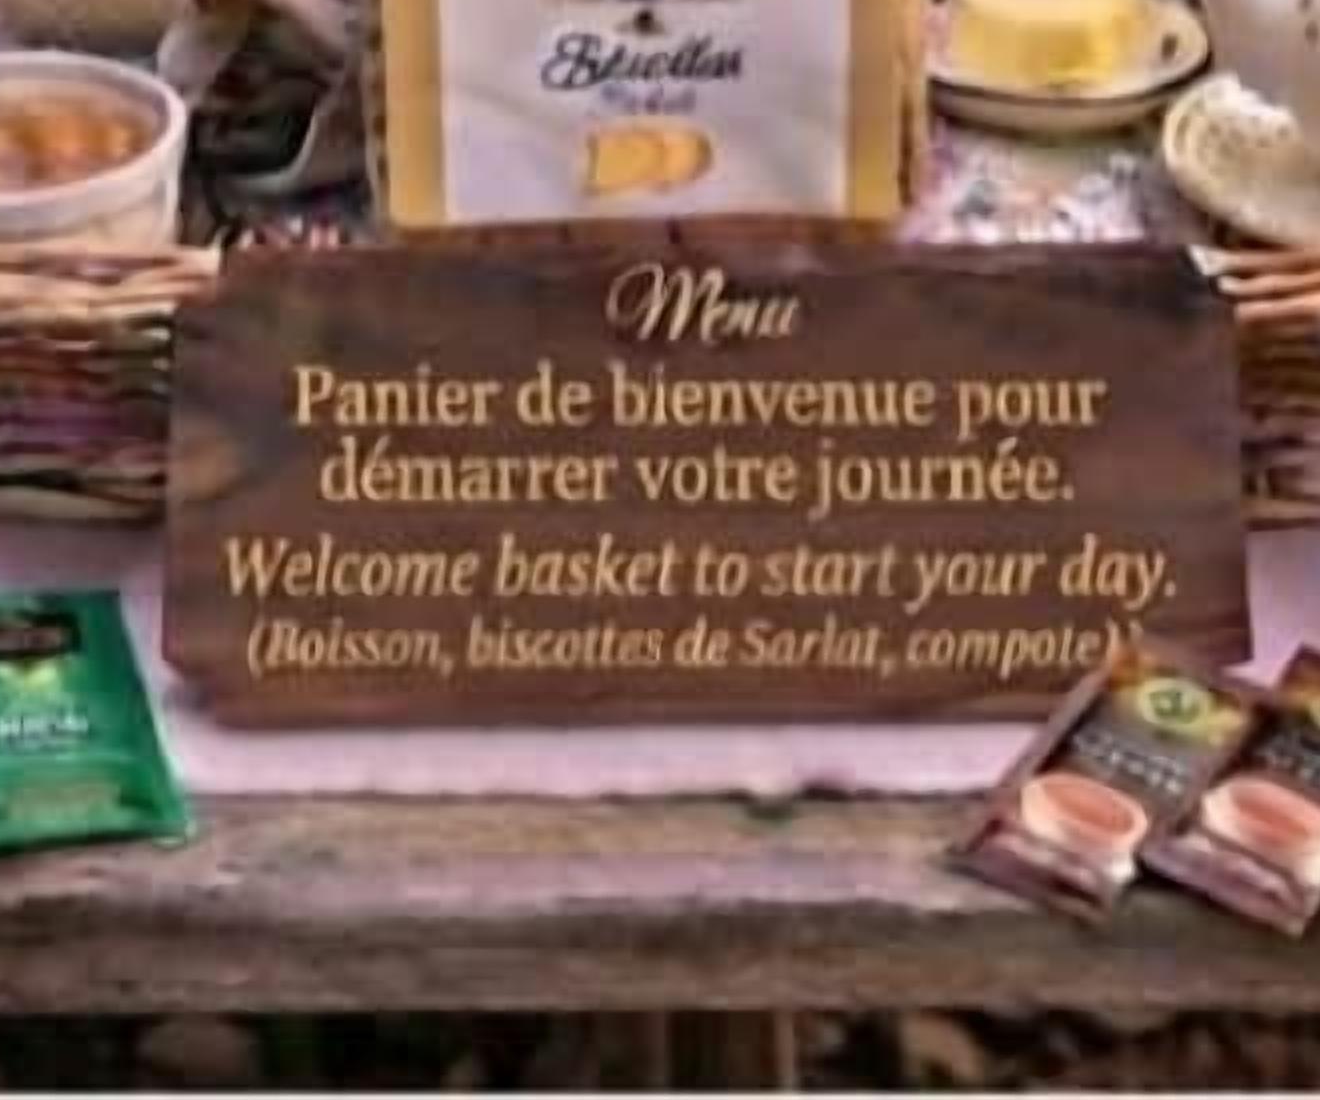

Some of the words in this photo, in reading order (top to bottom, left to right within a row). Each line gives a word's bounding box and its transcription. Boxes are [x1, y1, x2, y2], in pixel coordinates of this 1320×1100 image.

[604, 261, 799, 343] Menu
[293, 362, 500, 427] Panier
[515, 360, 592, 427] de
[608, 360, 936, 427] bienvenue
[952, 379, 1108, 442] pour
[320, 434, 618, 502] démarrer
[636, 446, 798, 502] votre
[806, 436, 1075, 522] journée.
[225, 532, 479, 598] Welcome
[496, 532, 675, 598] basket
[693, 544, 748, 598] to
[760, 544, 896, 598] start
[904, 550, 1047, 615] your
[1060, 532, 1176, 610] day.
[247, 616, 455, 682] (Boisson,
[673, 614, 729, 670] de
[742, 614, 892, 677] Sarlat,
